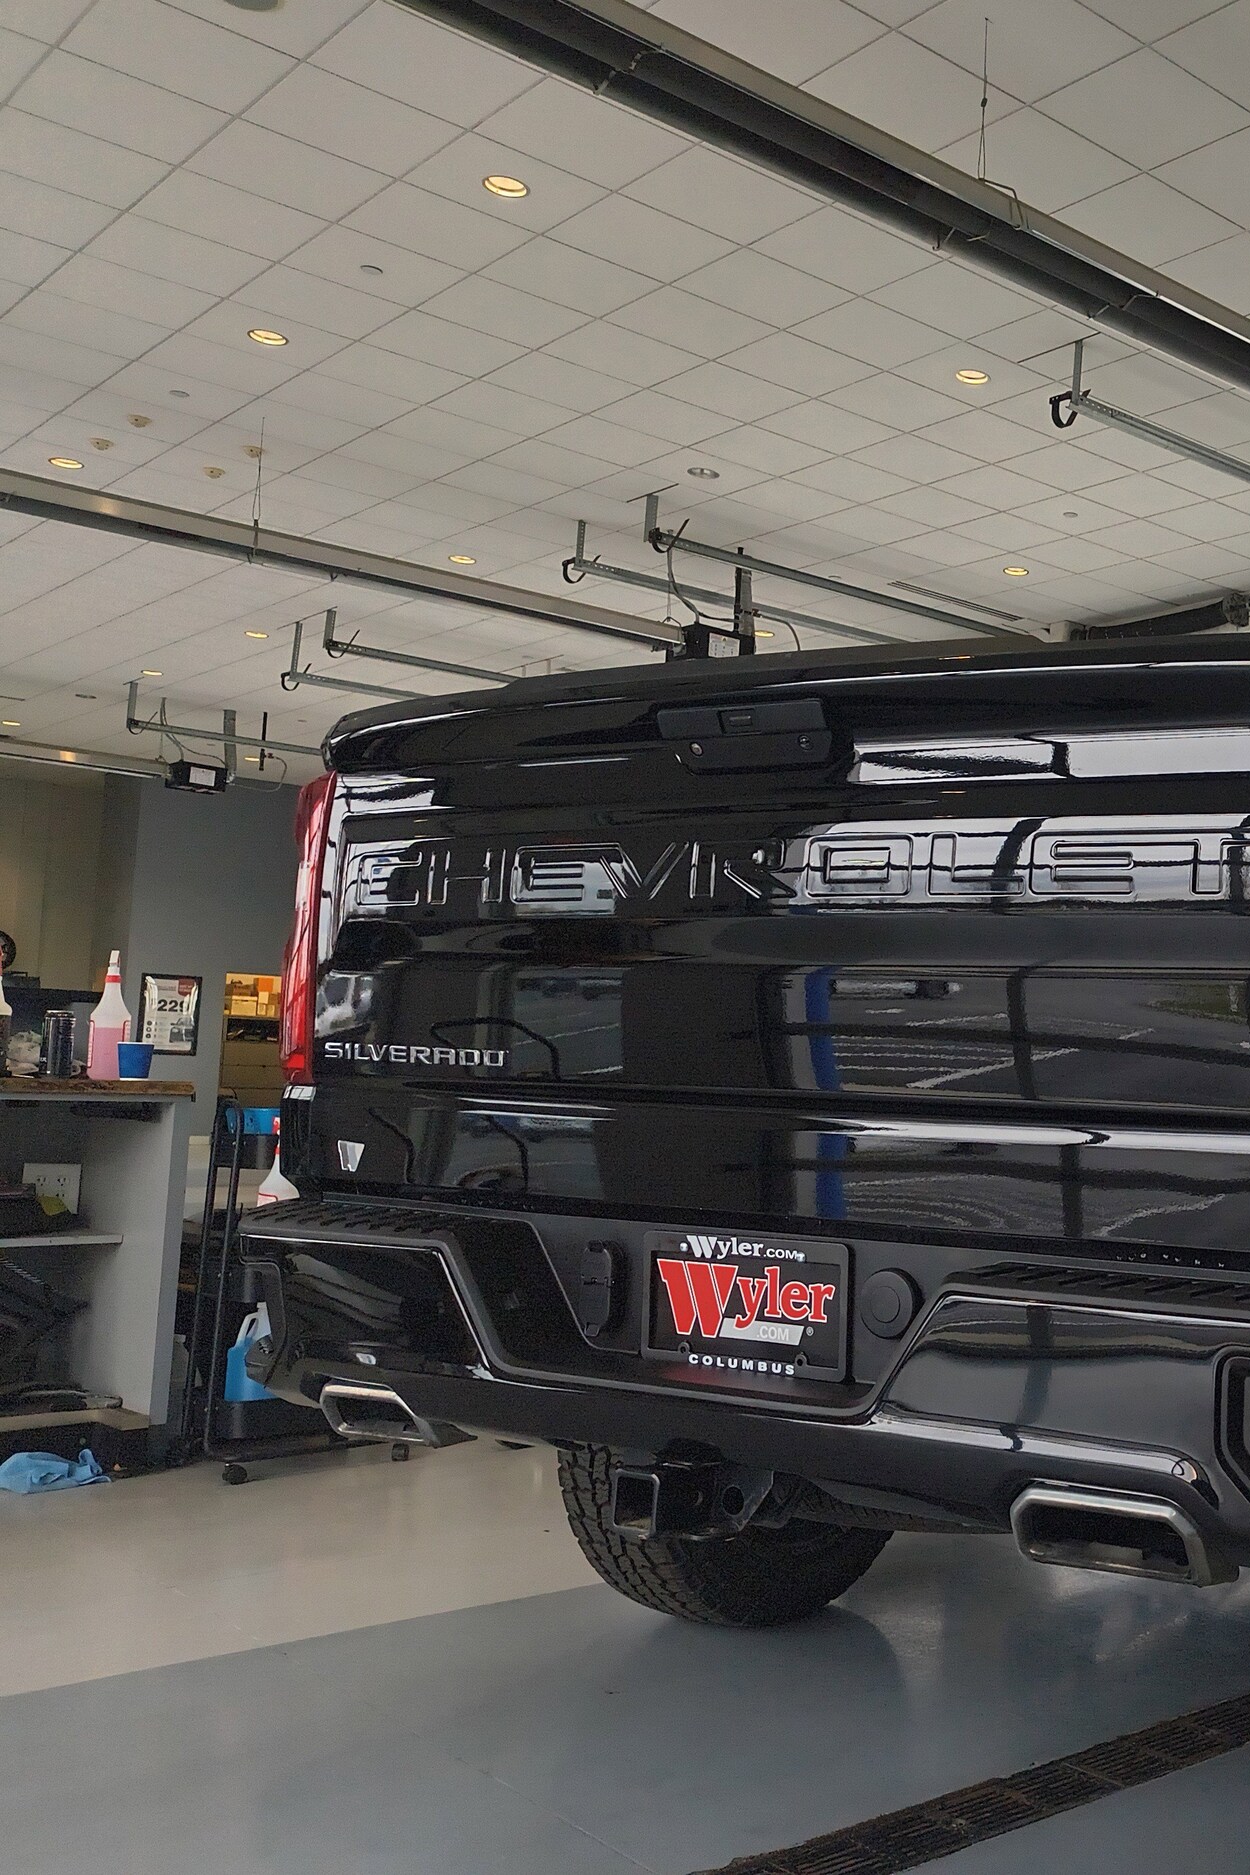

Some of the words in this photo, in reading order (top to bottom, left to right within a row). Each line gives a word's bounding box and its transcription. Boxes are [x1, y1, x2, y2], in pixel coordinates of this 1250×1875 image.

[324, 1042, 505, 1067] SILVERADO
[656, 1258, 836, 1339] Wyler
[688, 1354, 795, 1376] COLUMBUS
